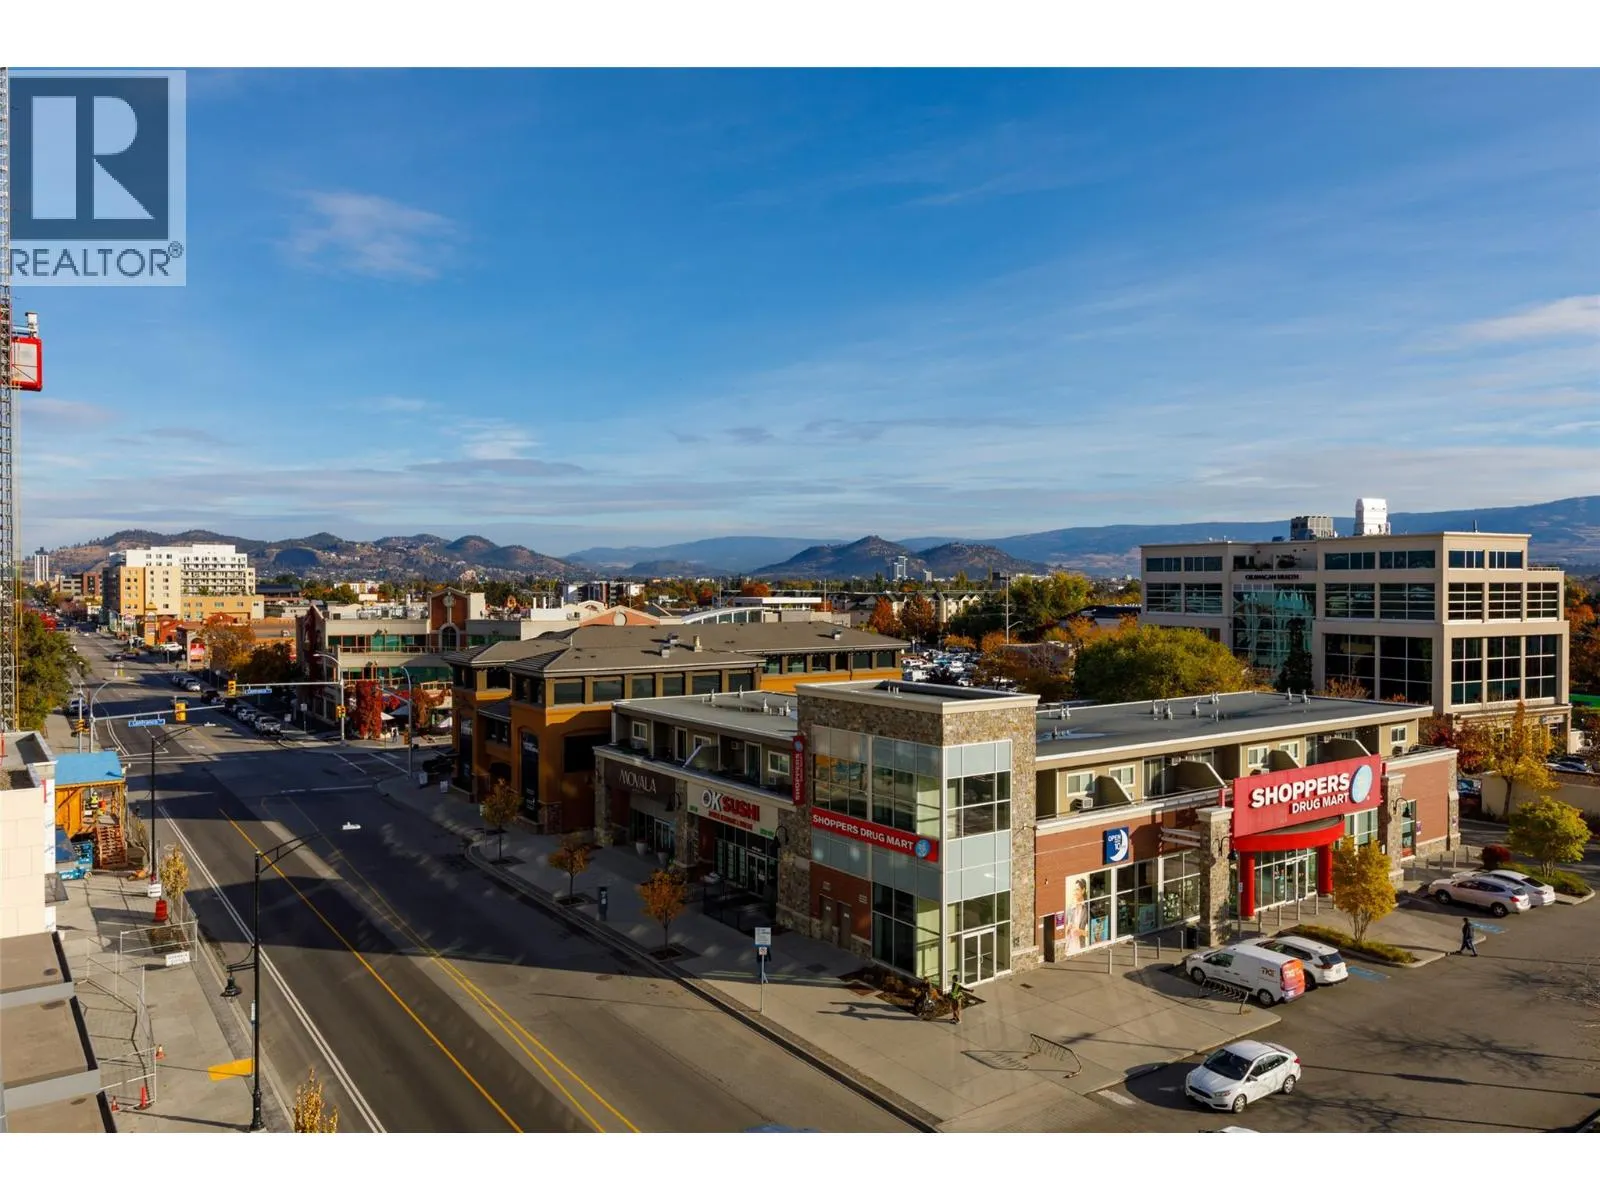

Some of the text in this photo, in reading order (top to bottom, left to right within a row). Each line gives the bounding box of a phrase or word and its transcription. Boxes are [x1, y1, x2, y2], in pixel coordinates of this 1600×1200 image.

[702, 790, 721, 812] OK
[720, 796, 760, 822] SUSHI
[1251, 772, 1351, 809] SHOPPERS
[1292, 791, 1350, 814] DRUG MART
[812, 814, 914, 851] SHOPPERS DRUG MART
